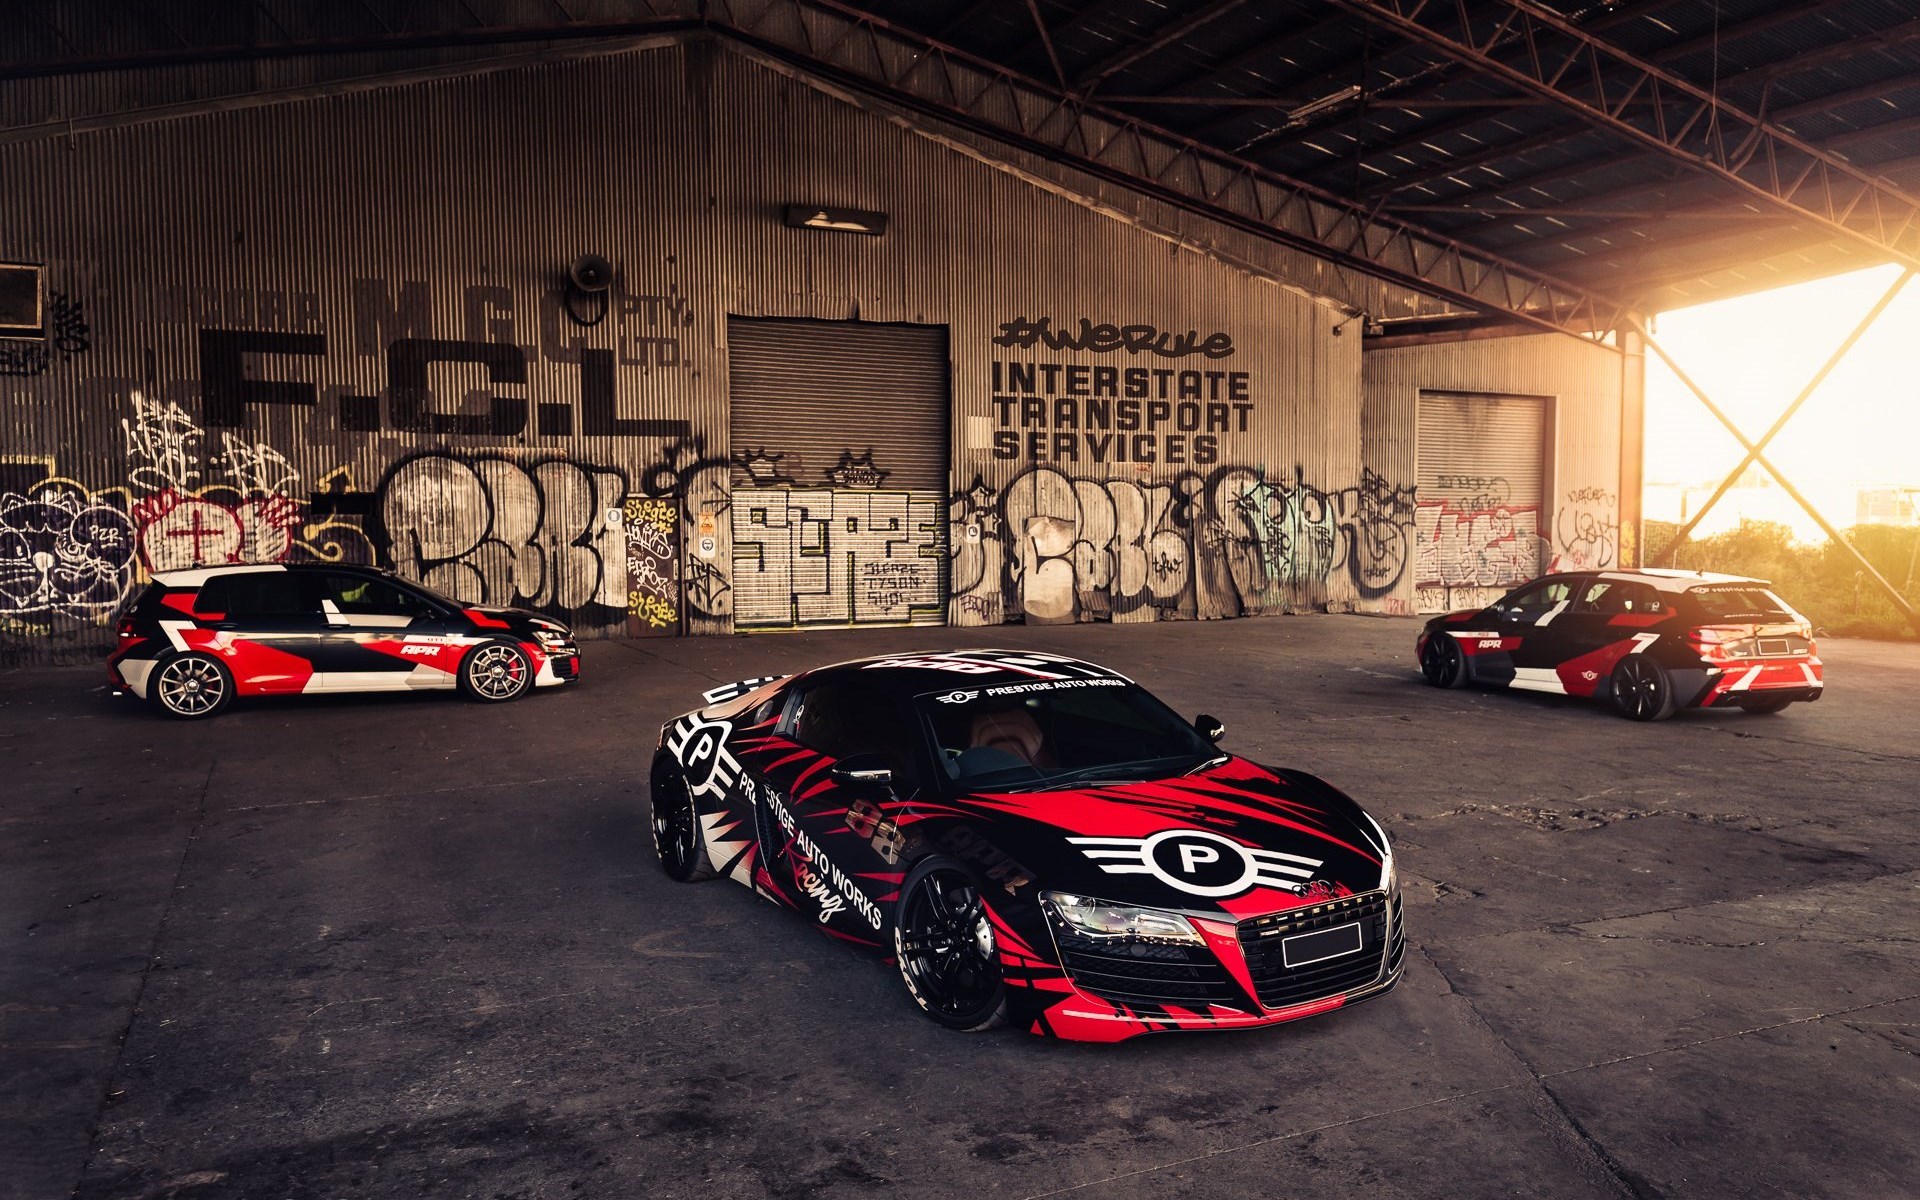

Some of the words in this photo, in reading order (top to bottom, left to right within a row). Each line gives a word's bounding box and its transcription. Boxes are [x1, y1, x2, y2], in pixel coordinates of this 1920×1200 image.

[992, 361, 1250, 400] INTERSTATE
[993, 396, 1254, 432] TRANSPORT
[993, 431, 1218, 464] SERVICES
[400, 644, 441, 656] APR
[1478, 639, 1503, 649] APR
[986, 682, 1053, 697] PRESTIGE
[1053, 679, 1087, 690] AUTO
[1085, 678, 1126, 687] WORKS
[687, 732, 714, 767] P
[739, 771, 795, 838] PRESTIGE
[797, 829, 829, 876] AUTO
[832, 863, 882, 930] WORKS
[1178, 843, 1220, 873] P
